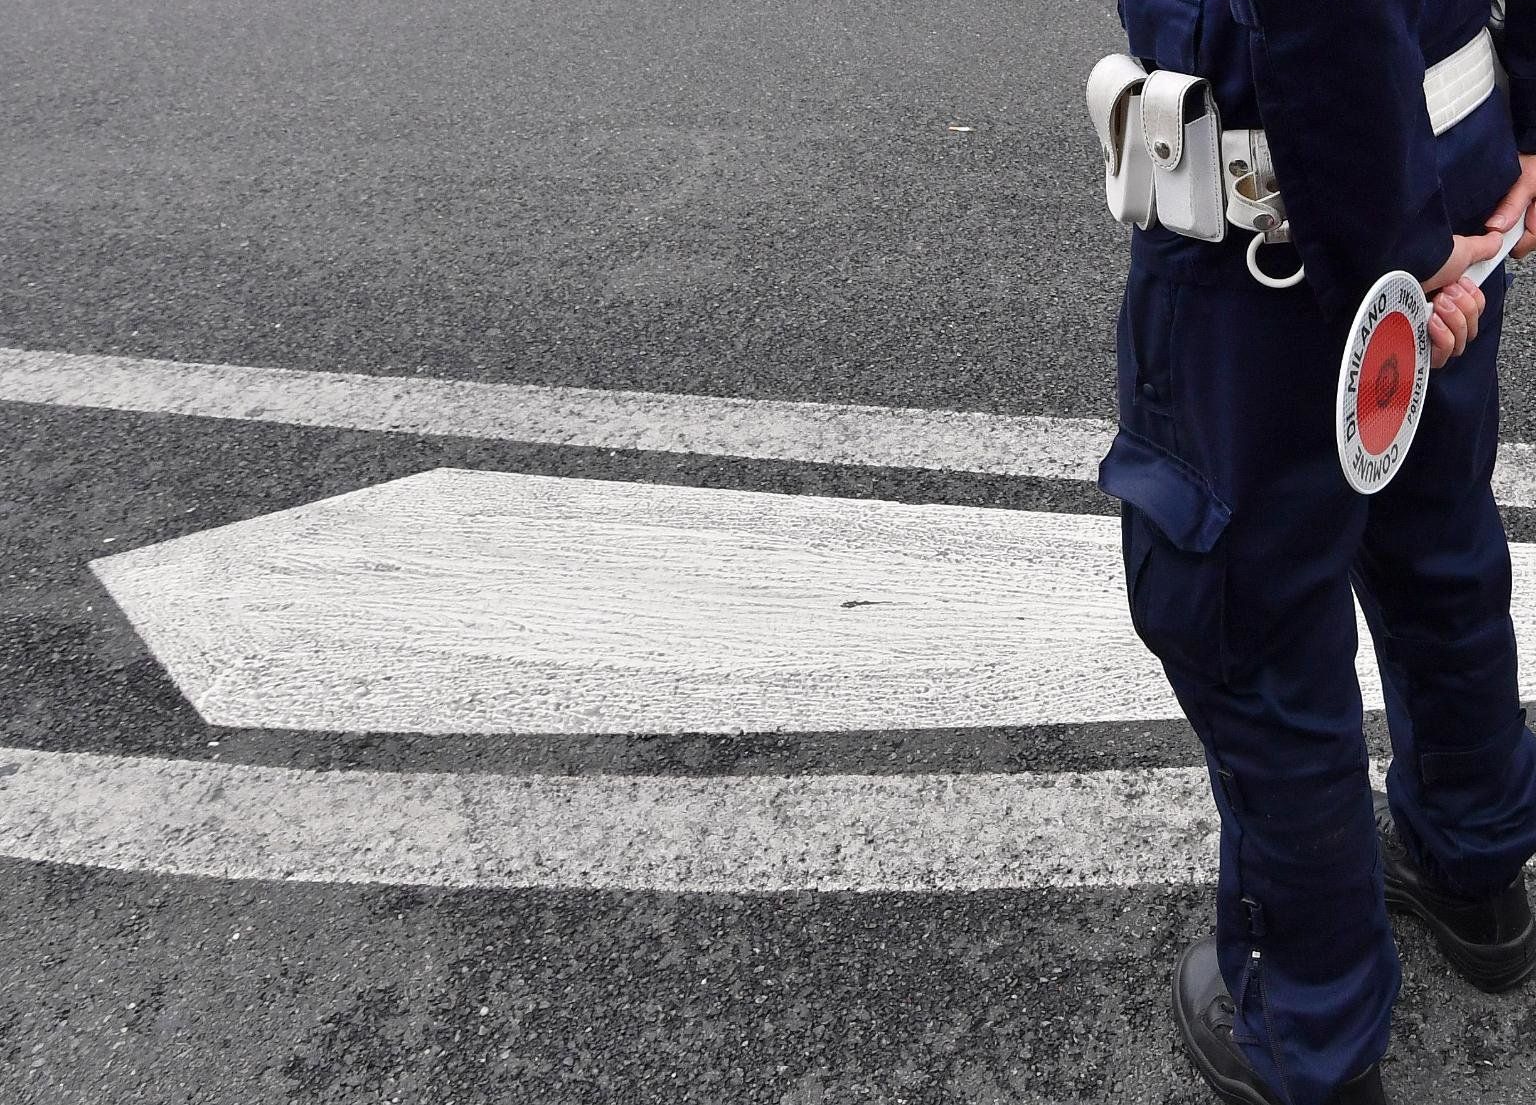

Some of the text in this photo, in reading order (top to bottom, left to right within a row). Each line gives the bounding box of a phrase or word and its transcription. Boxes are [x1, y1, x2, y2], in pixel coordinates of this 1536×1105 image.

[1398, 289, 1419, 319] LOCALE
[1346, 293, 1398, 483] COMUNE DI MILANO
[1407, 367, 1425, 424] POLIZIA
